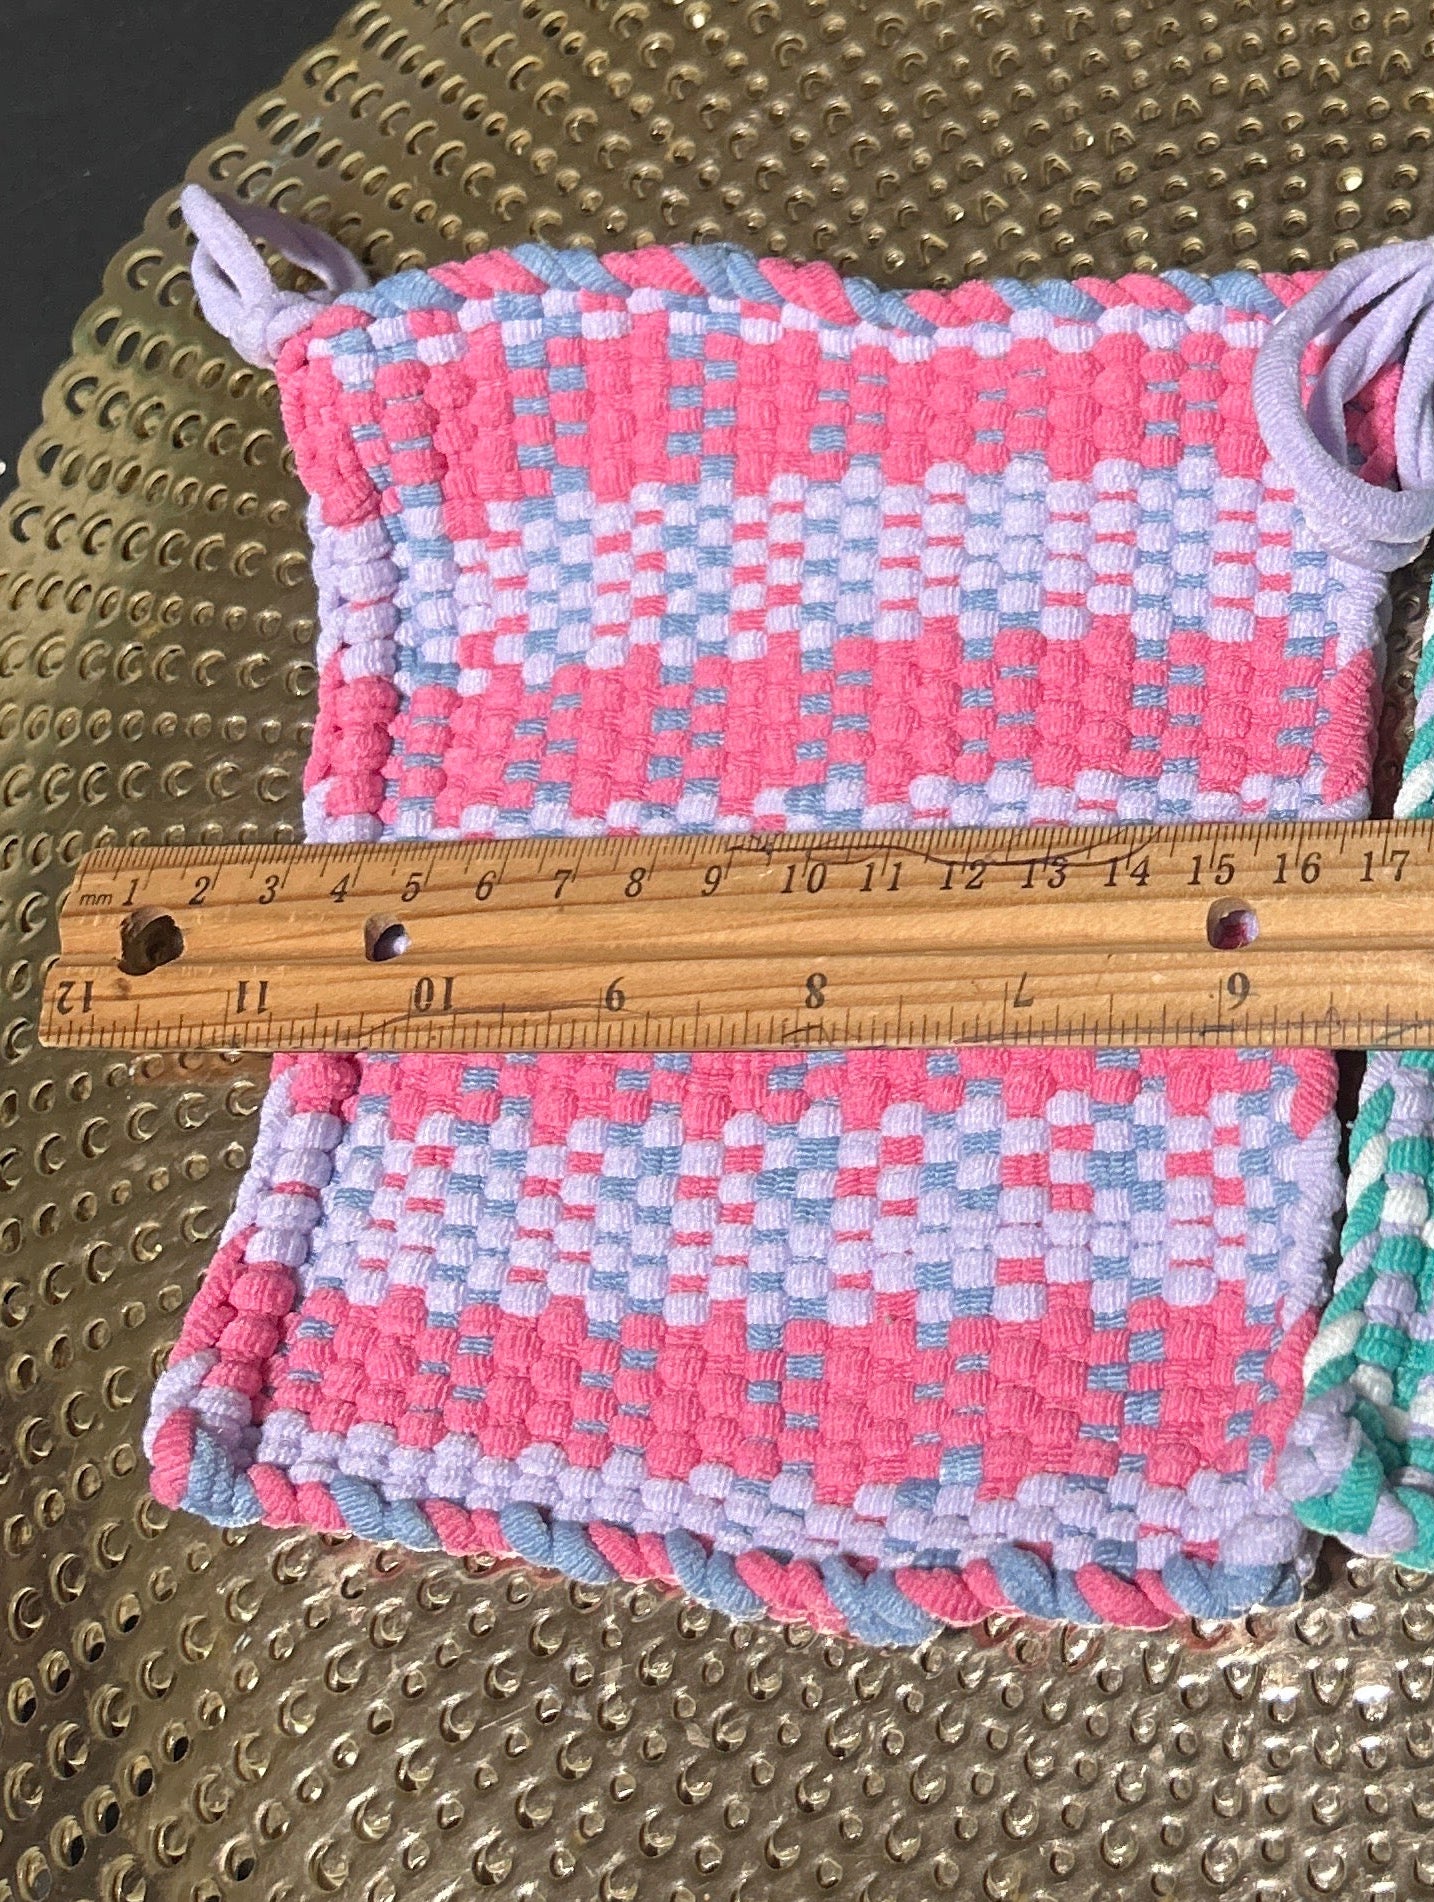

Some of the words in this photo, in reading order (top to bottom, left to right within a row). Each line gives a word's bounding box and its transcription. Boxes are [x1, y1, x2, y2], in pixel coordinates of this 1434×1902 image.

[79, 891, 113, 906] mm
[121, 878, 140, 907] 1
[189, 876, 211, 906] 2
[259, 875, 280, 905] 3
[329, 873, 352, 903] 4
[401, 871, 424, 902] 5
[475, 870, 498, 901] 6
[553, 869, 574, 899] 7
[624, 867, 647, 897] 8
[701, 865, 723, 896] 9
[780, 862, 828, 894] 10
[859, 861, 904, 892] 11
[939, 860, 987, 891] 12
[1020, 856, 1068, 889] 13
[1103, 854, 1151, 887] 14
[1187, 853, 1236, 886] 15
[1272, 851, 1321, 884] 16
[1359, 849, 1411, 883] 17
[56, 980, 94, 1015] 12
[235, 979, 269, 1014] 11
[413, 977, 455, 1011] 10
[605, 976, 626, 1012] 9
[804, 972, 828, 1009] 8
[1012, 971, 1034, 1008] 7
[1226, 971, 1252, 1011] 6
